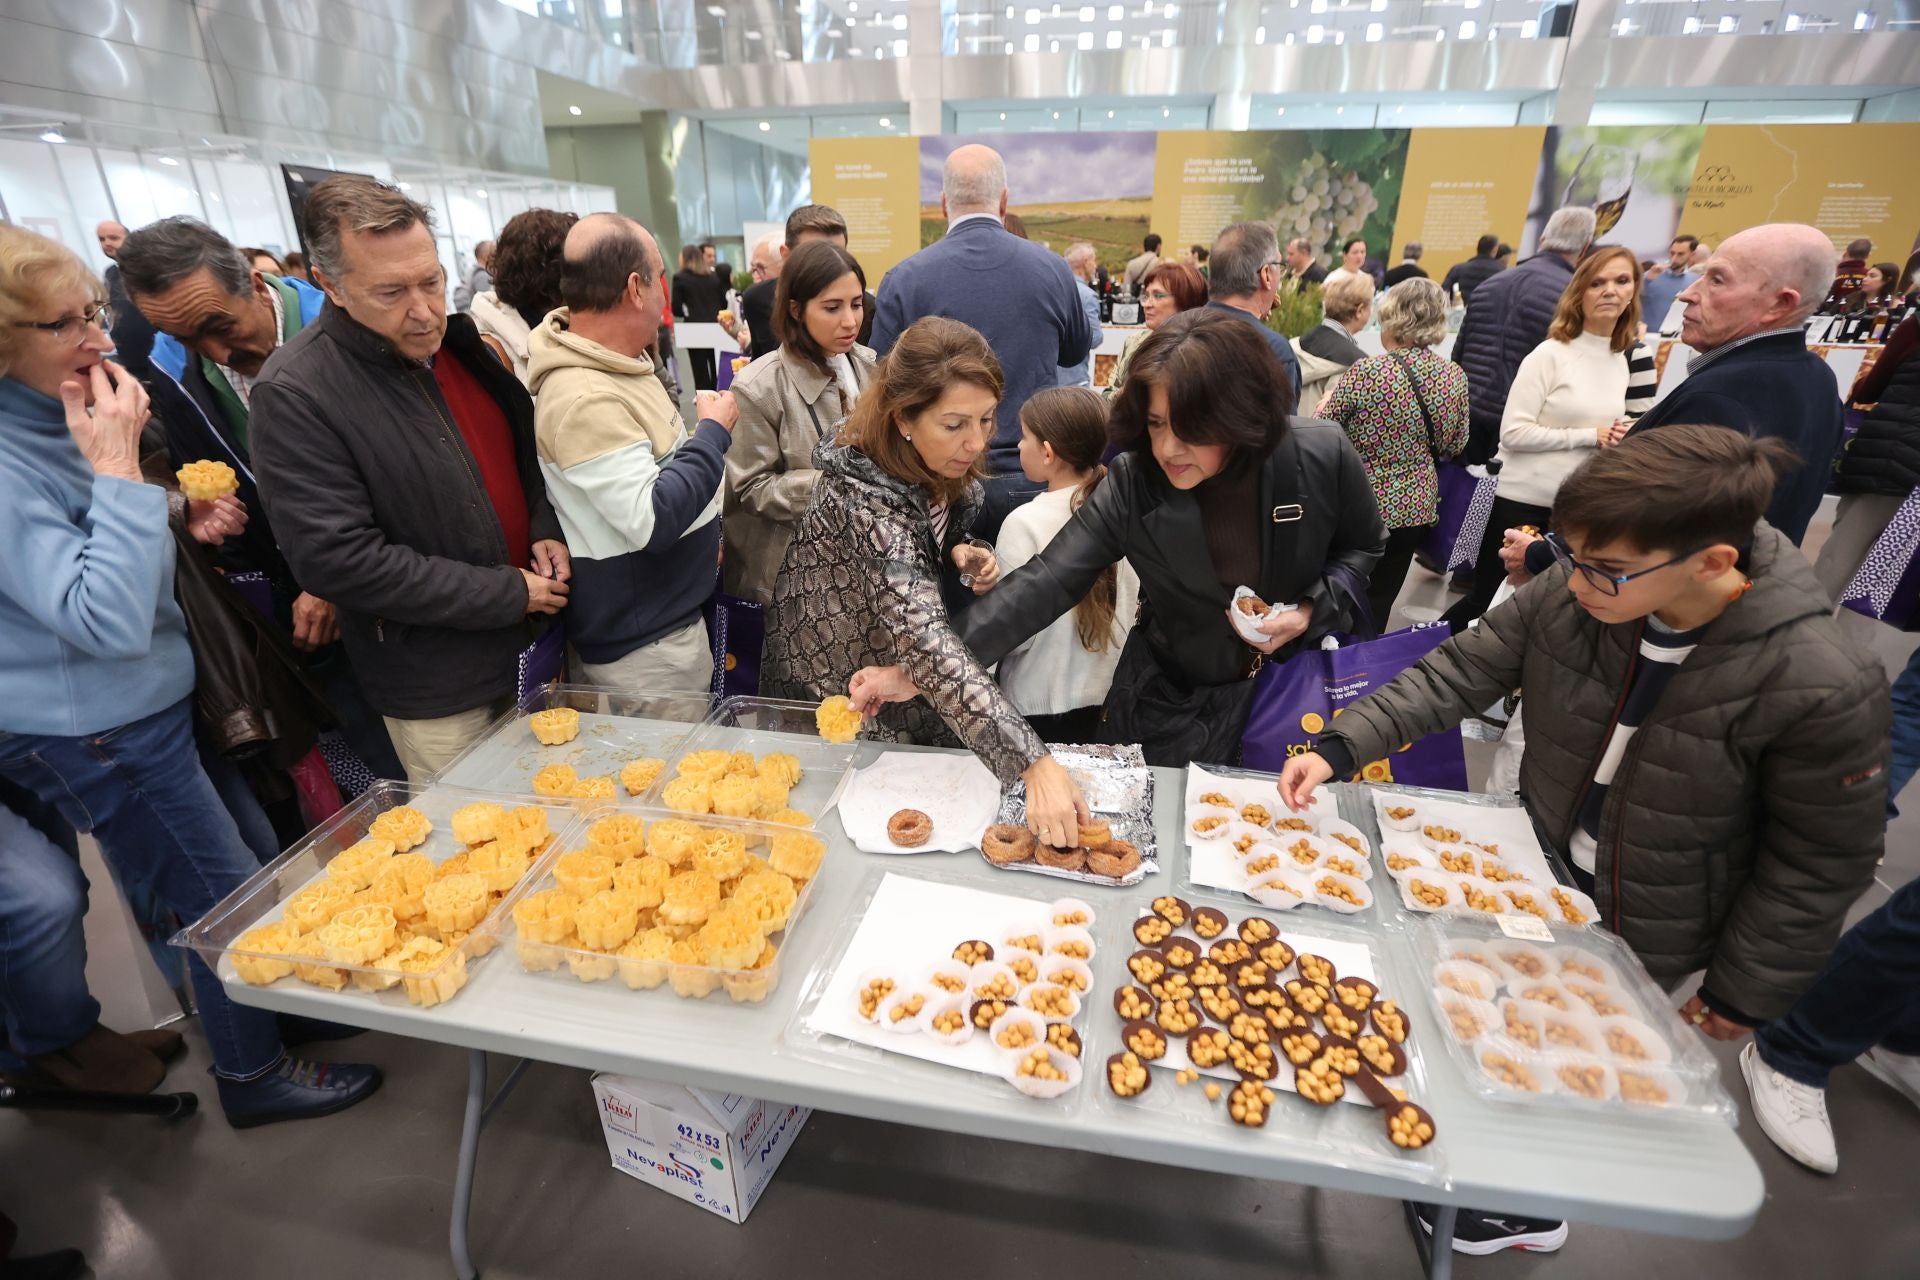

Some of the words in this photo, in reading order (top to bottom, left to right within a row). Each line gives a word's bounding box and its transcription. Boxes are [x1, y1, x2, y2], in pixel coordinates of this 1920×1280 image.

[1350, 680, 1369, 690] mejor
[677, 1123, 694, 1139] 42
[704, 1133, 720, 1150] 53
[626, 1147, 704, 1190] Nevaplast
